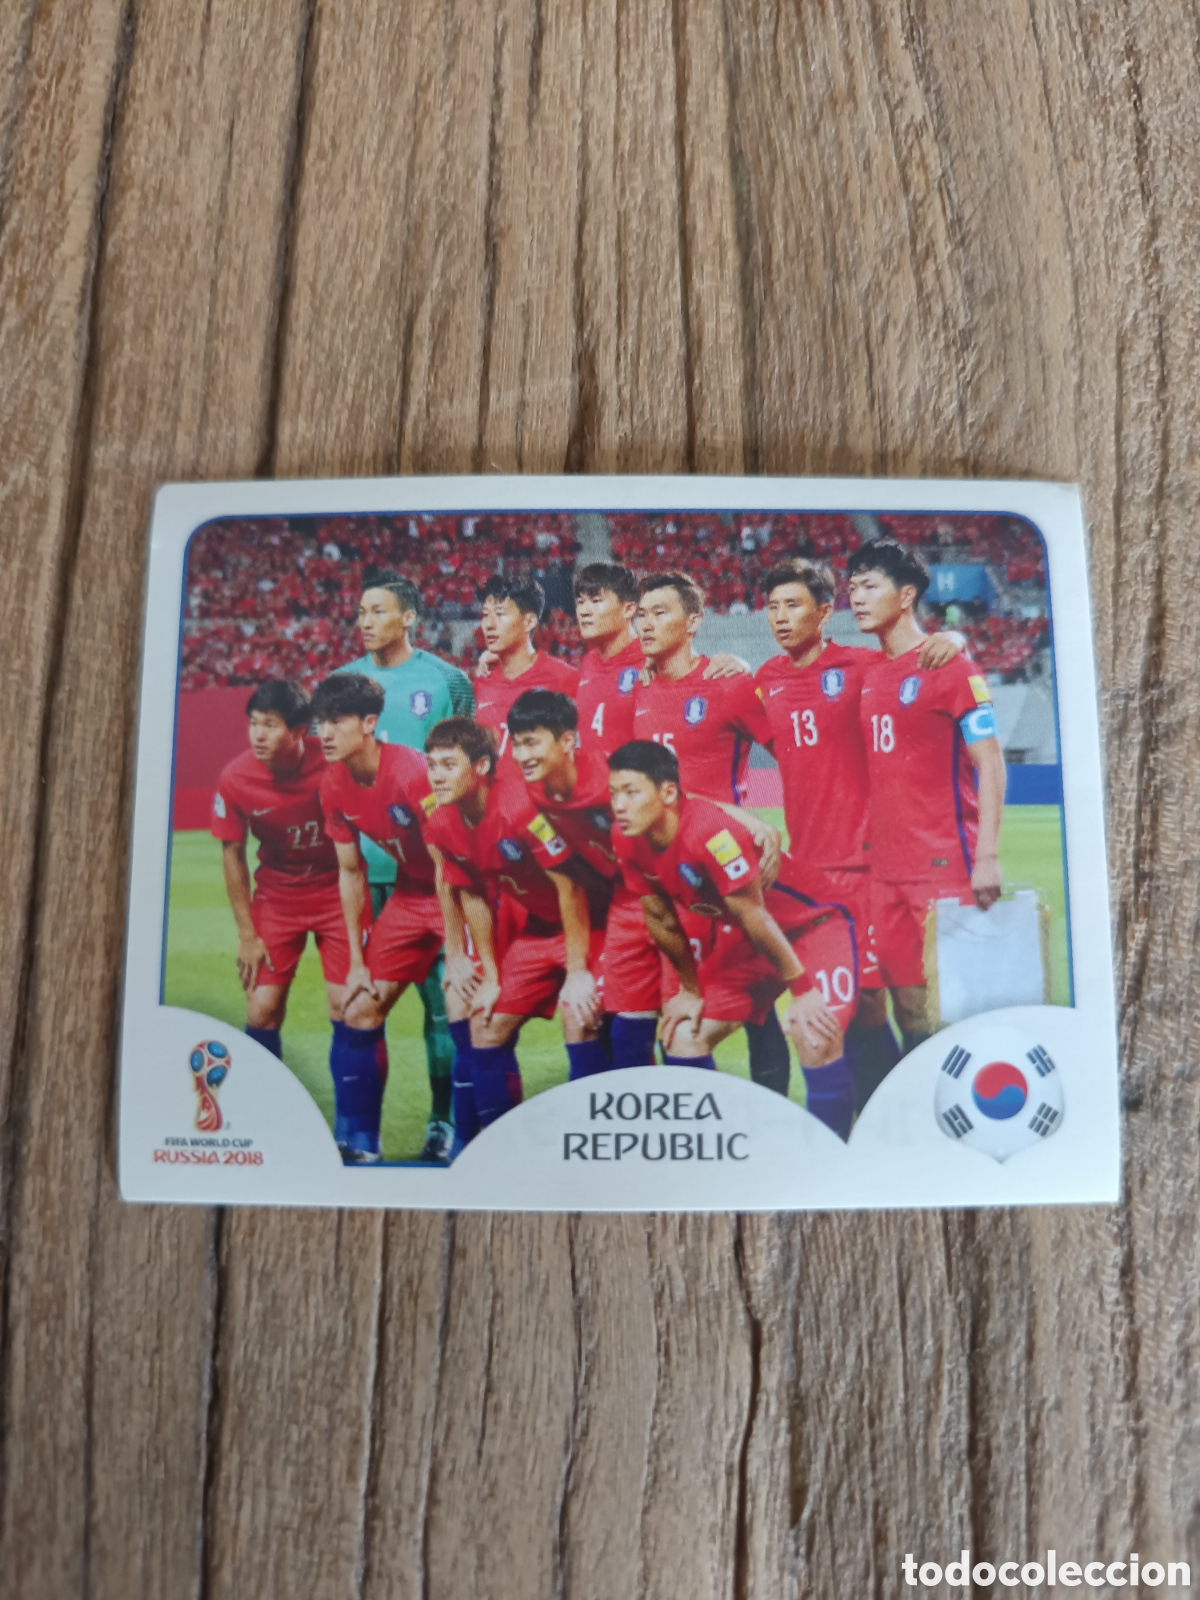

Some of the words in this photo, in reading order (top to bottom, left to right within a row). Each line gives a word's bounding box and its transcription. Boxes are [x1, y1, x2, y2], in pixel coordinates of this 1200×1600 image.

[591, 702, 606, 738] 4
[790, 709, 819, 748] 13
[870, 714, 896, 754] 18
[968, 709, 994, 737] C
[287, 820, 324, 849] 22
[815, 965, 855, 1004] 10
[589, 1092, 723, 1121] KOREA
[153, 1149, 220, 1164] RUSSIA
[223, 1150, 264, 1165] 2018
[164, 1137, 189, 1147] FIFA
[190, 1137, 231, 1148] WORLD
[231, 1138, 254, 1148] CUP
[563, 1132, 750, 1161] REPUBLIC
